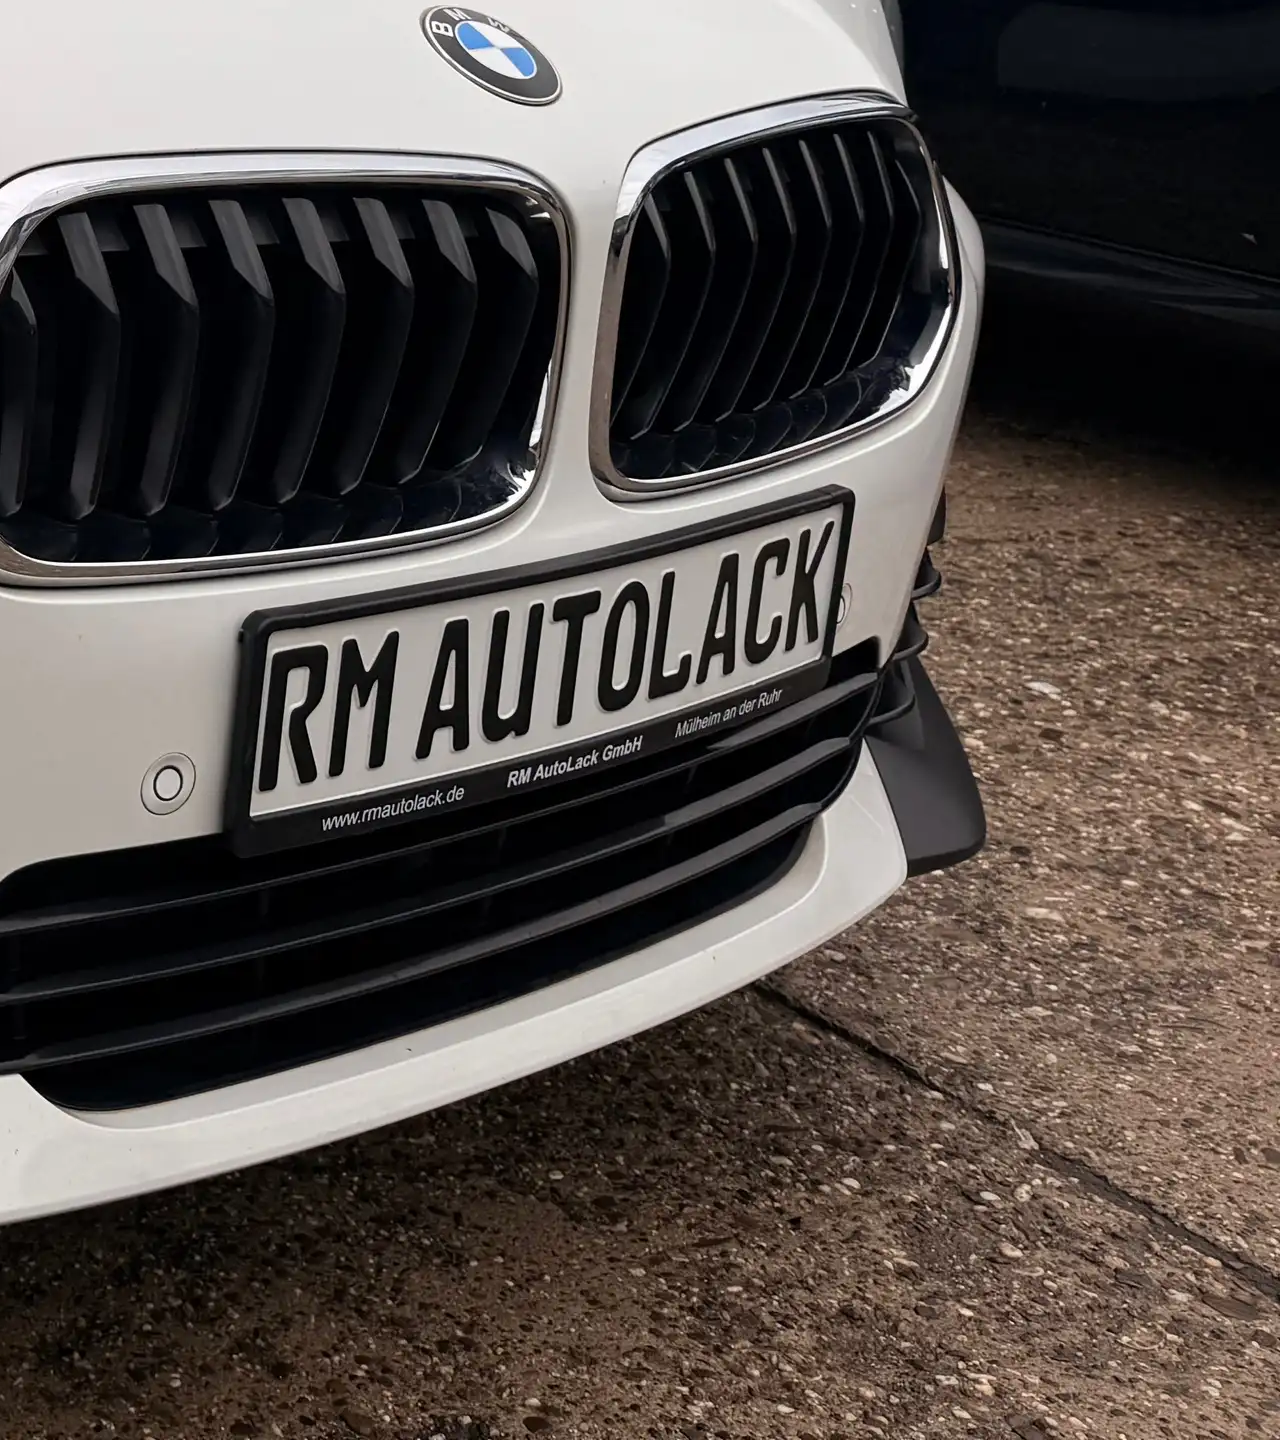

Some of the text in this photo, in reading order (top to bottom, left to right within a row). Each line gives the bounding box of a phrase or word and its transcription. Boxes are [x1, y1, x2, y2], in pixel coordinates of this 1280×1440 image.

[257, 520, 835, 792] RM AUTOLACK
[674, 688, 783, 738] Mülheim an der Ruhr
[506, 735, 644, 788] RM AutoLack GmbH
[321, 784, 465, 832] www.rmautolack.de
